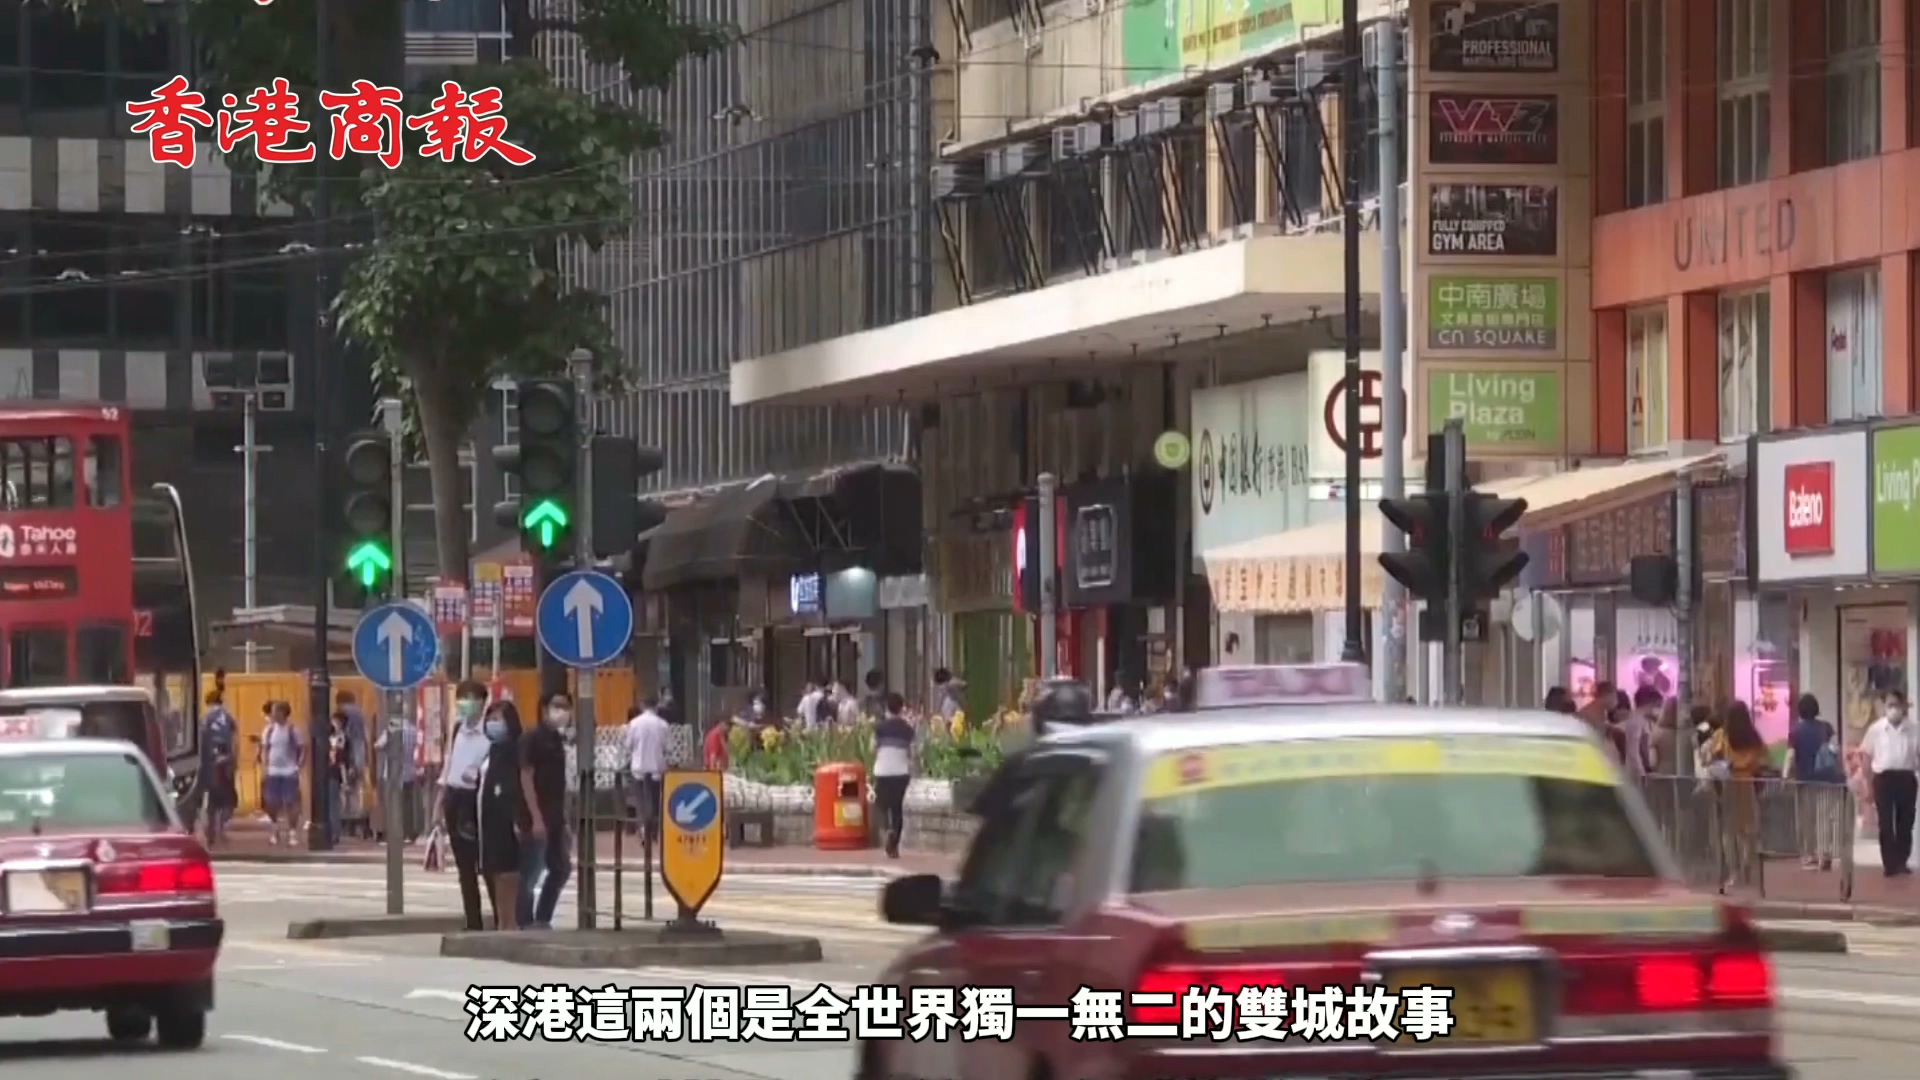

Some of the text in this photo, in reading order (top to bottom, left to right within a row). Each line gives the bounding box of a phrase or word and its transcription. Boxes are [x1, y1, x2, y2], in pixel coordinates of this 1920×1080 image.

[1462, 39, 1551, 55] PROFESSIONAL
[1432, 220, 1505, 232] FULLY EQUIPPED
[1673, 198, 1796, 272] UNITED
[1433, 233, 1505, 250] GYM AREA
[1438, 282, 1547, 309] 中南廣場
[1474, 330, 1547, 346] SQUARE
[1450, 373, 1536, 403] Living
[1450, 400, 1524, 424] Plaza
[1876, 460, 1910, 512] Living
[1789, 484, 1824, 528] Baleno
[20, 525, 77, 542] Tahoe
